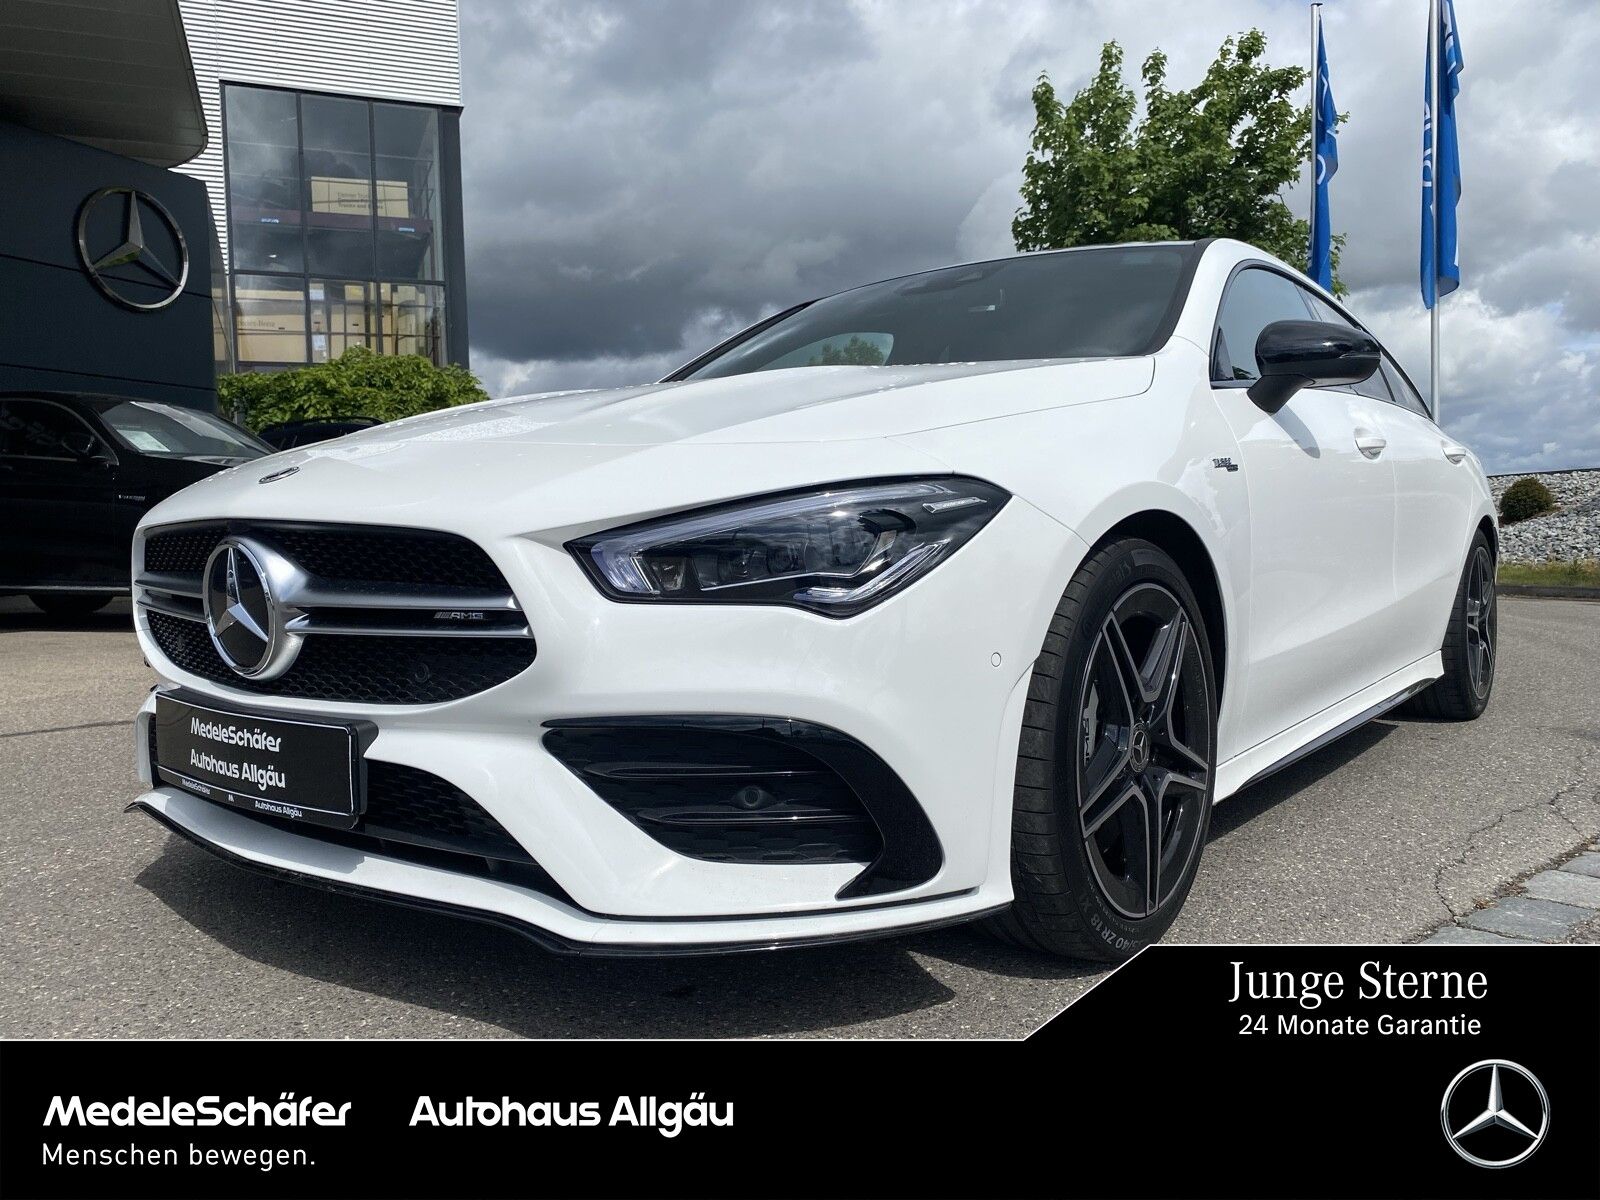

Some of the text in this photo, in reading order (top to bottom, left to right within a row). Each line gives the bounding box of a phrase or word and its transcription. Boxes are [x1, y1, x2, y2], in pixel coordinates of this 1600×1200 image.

[190, 716, 282, 753] MedeleSchäfer
[190, 748, 286, 791] Autohaus Allgäu
[255, 800, 303, 819] Autohaus Allgäu
